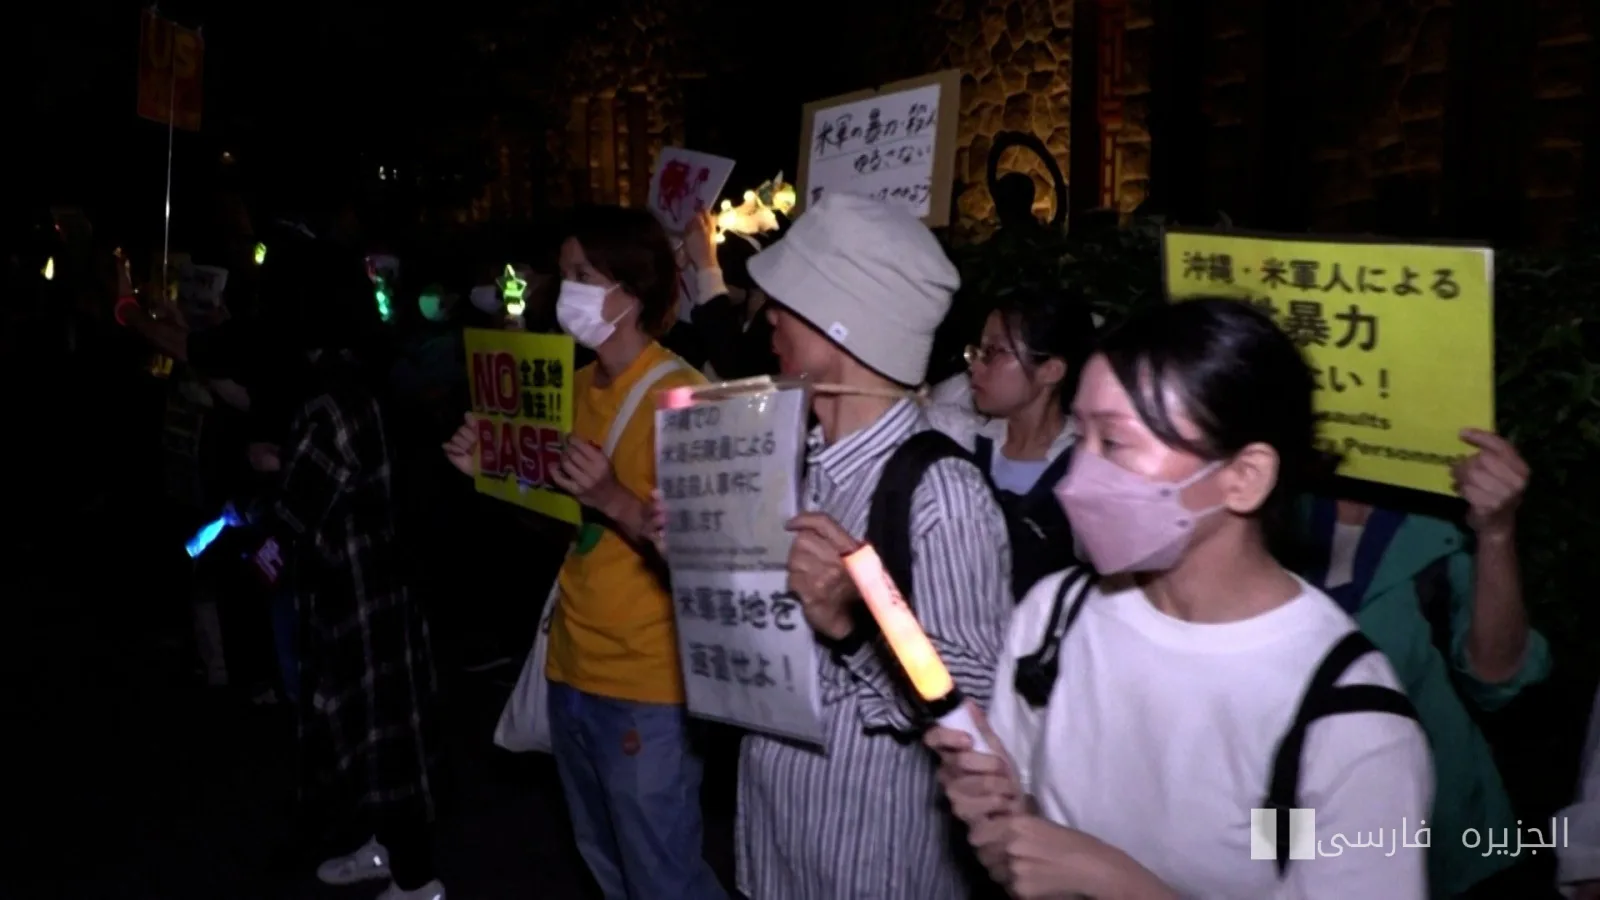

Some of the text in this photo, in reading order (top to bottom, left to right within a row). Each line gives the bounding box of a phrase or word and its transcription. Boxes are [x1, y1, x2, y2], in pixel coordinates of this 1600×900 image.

[1183, 251, 1461, 300] 沖縄・米軍人による
[1262, 297, 1380, 352] 暴力
[473, 351, 519, 415] NO
[478, 417, 563, 489] BASE
